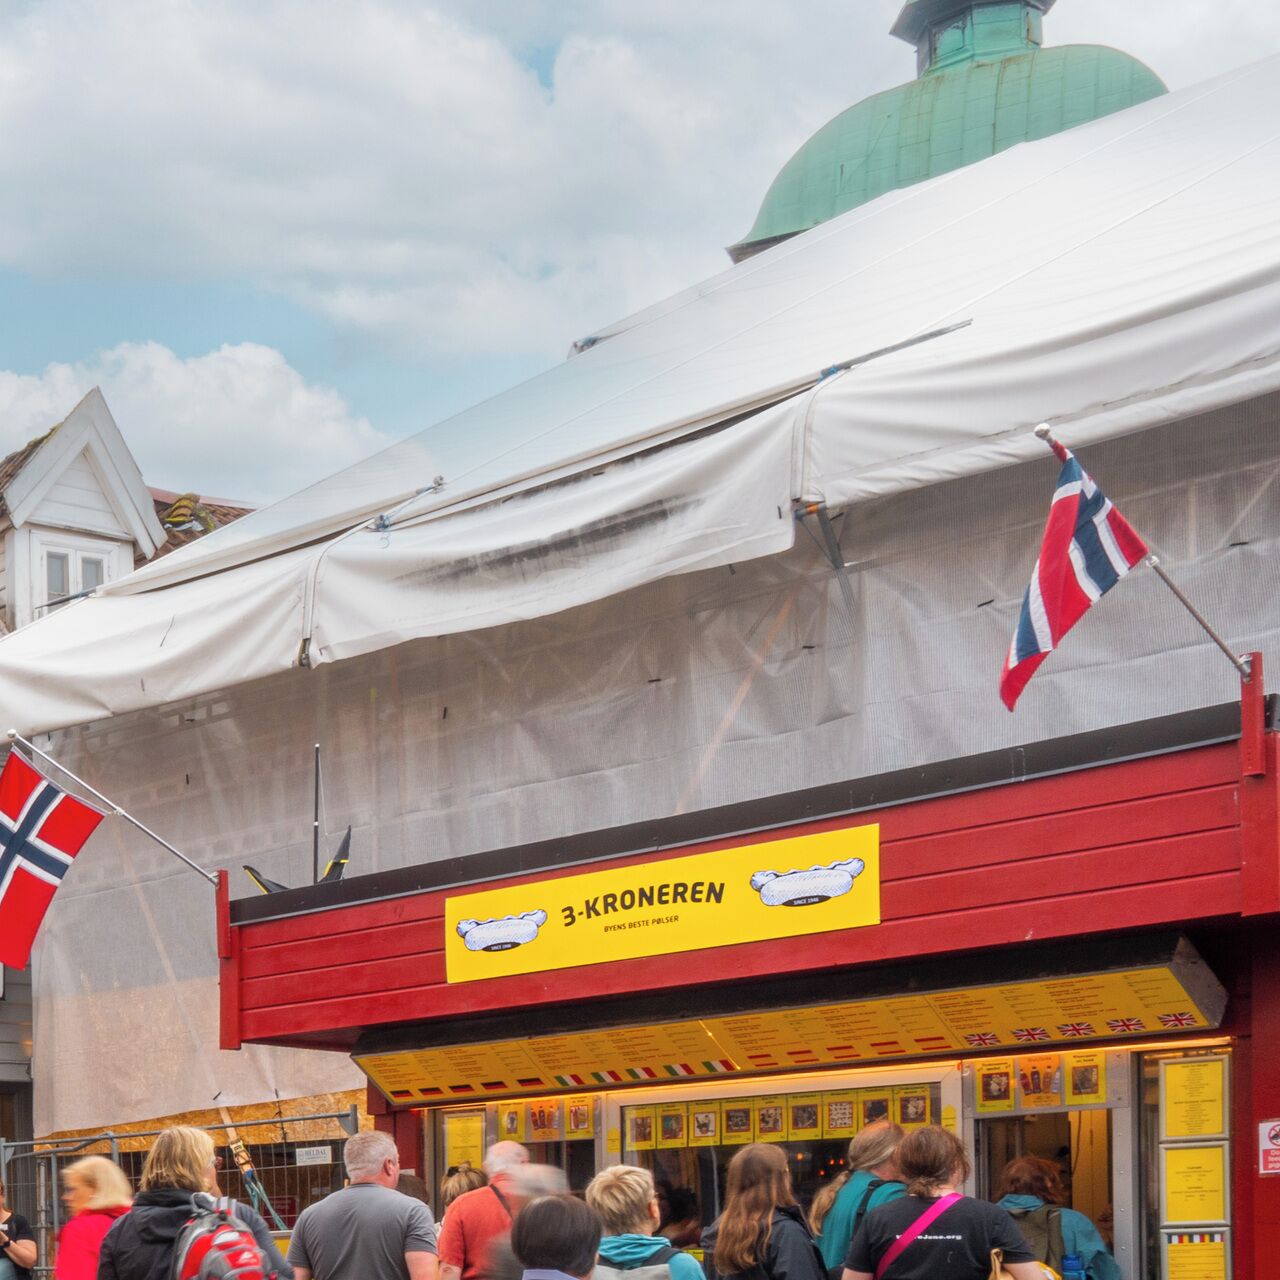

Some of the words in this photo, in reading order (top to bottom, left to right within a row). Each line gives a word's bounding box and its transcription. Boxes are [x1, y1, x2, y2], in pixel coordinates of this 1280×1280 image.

[561, 881, 726, 928] 3-KRONEREN
[603, 922, 627, 933] BYENS
[628, 919, 650, 929] BESTE
[651, 915, 679, 926] PØLSER
